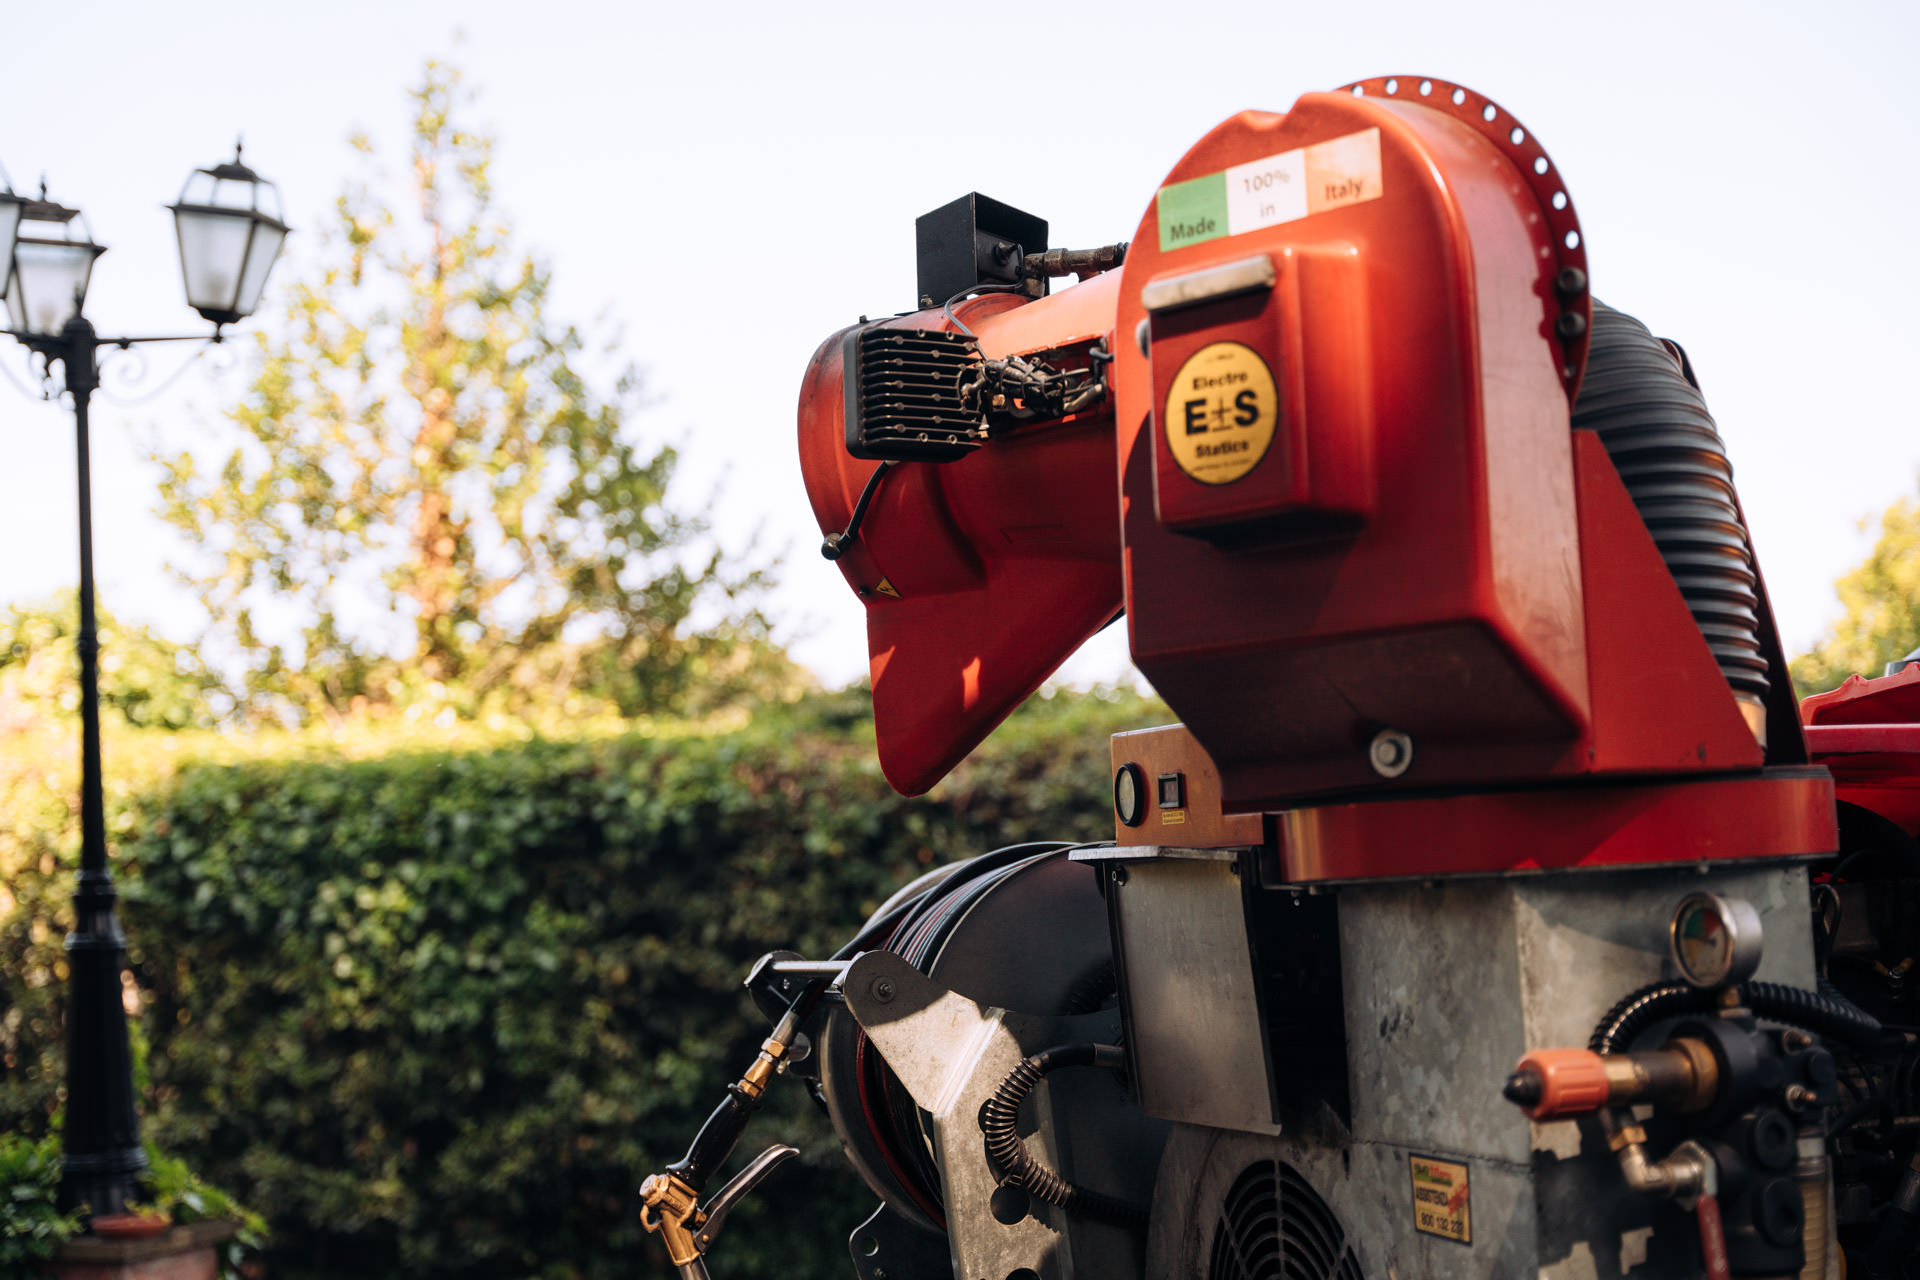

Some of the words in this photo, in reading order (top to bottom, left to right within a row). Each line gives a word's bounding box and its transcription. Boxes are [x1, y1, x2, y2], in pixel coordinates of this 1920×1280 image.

[1243, 169, 1290, 193] 100%
[1169, 217, 1216, 242] Made
[1260, 203, 1276, 218] in
[1324, 178, 1363, 201] Italy
[1192, 371, 1249, 391] Electro
[1421, 1212, 1435, 1228] 800
